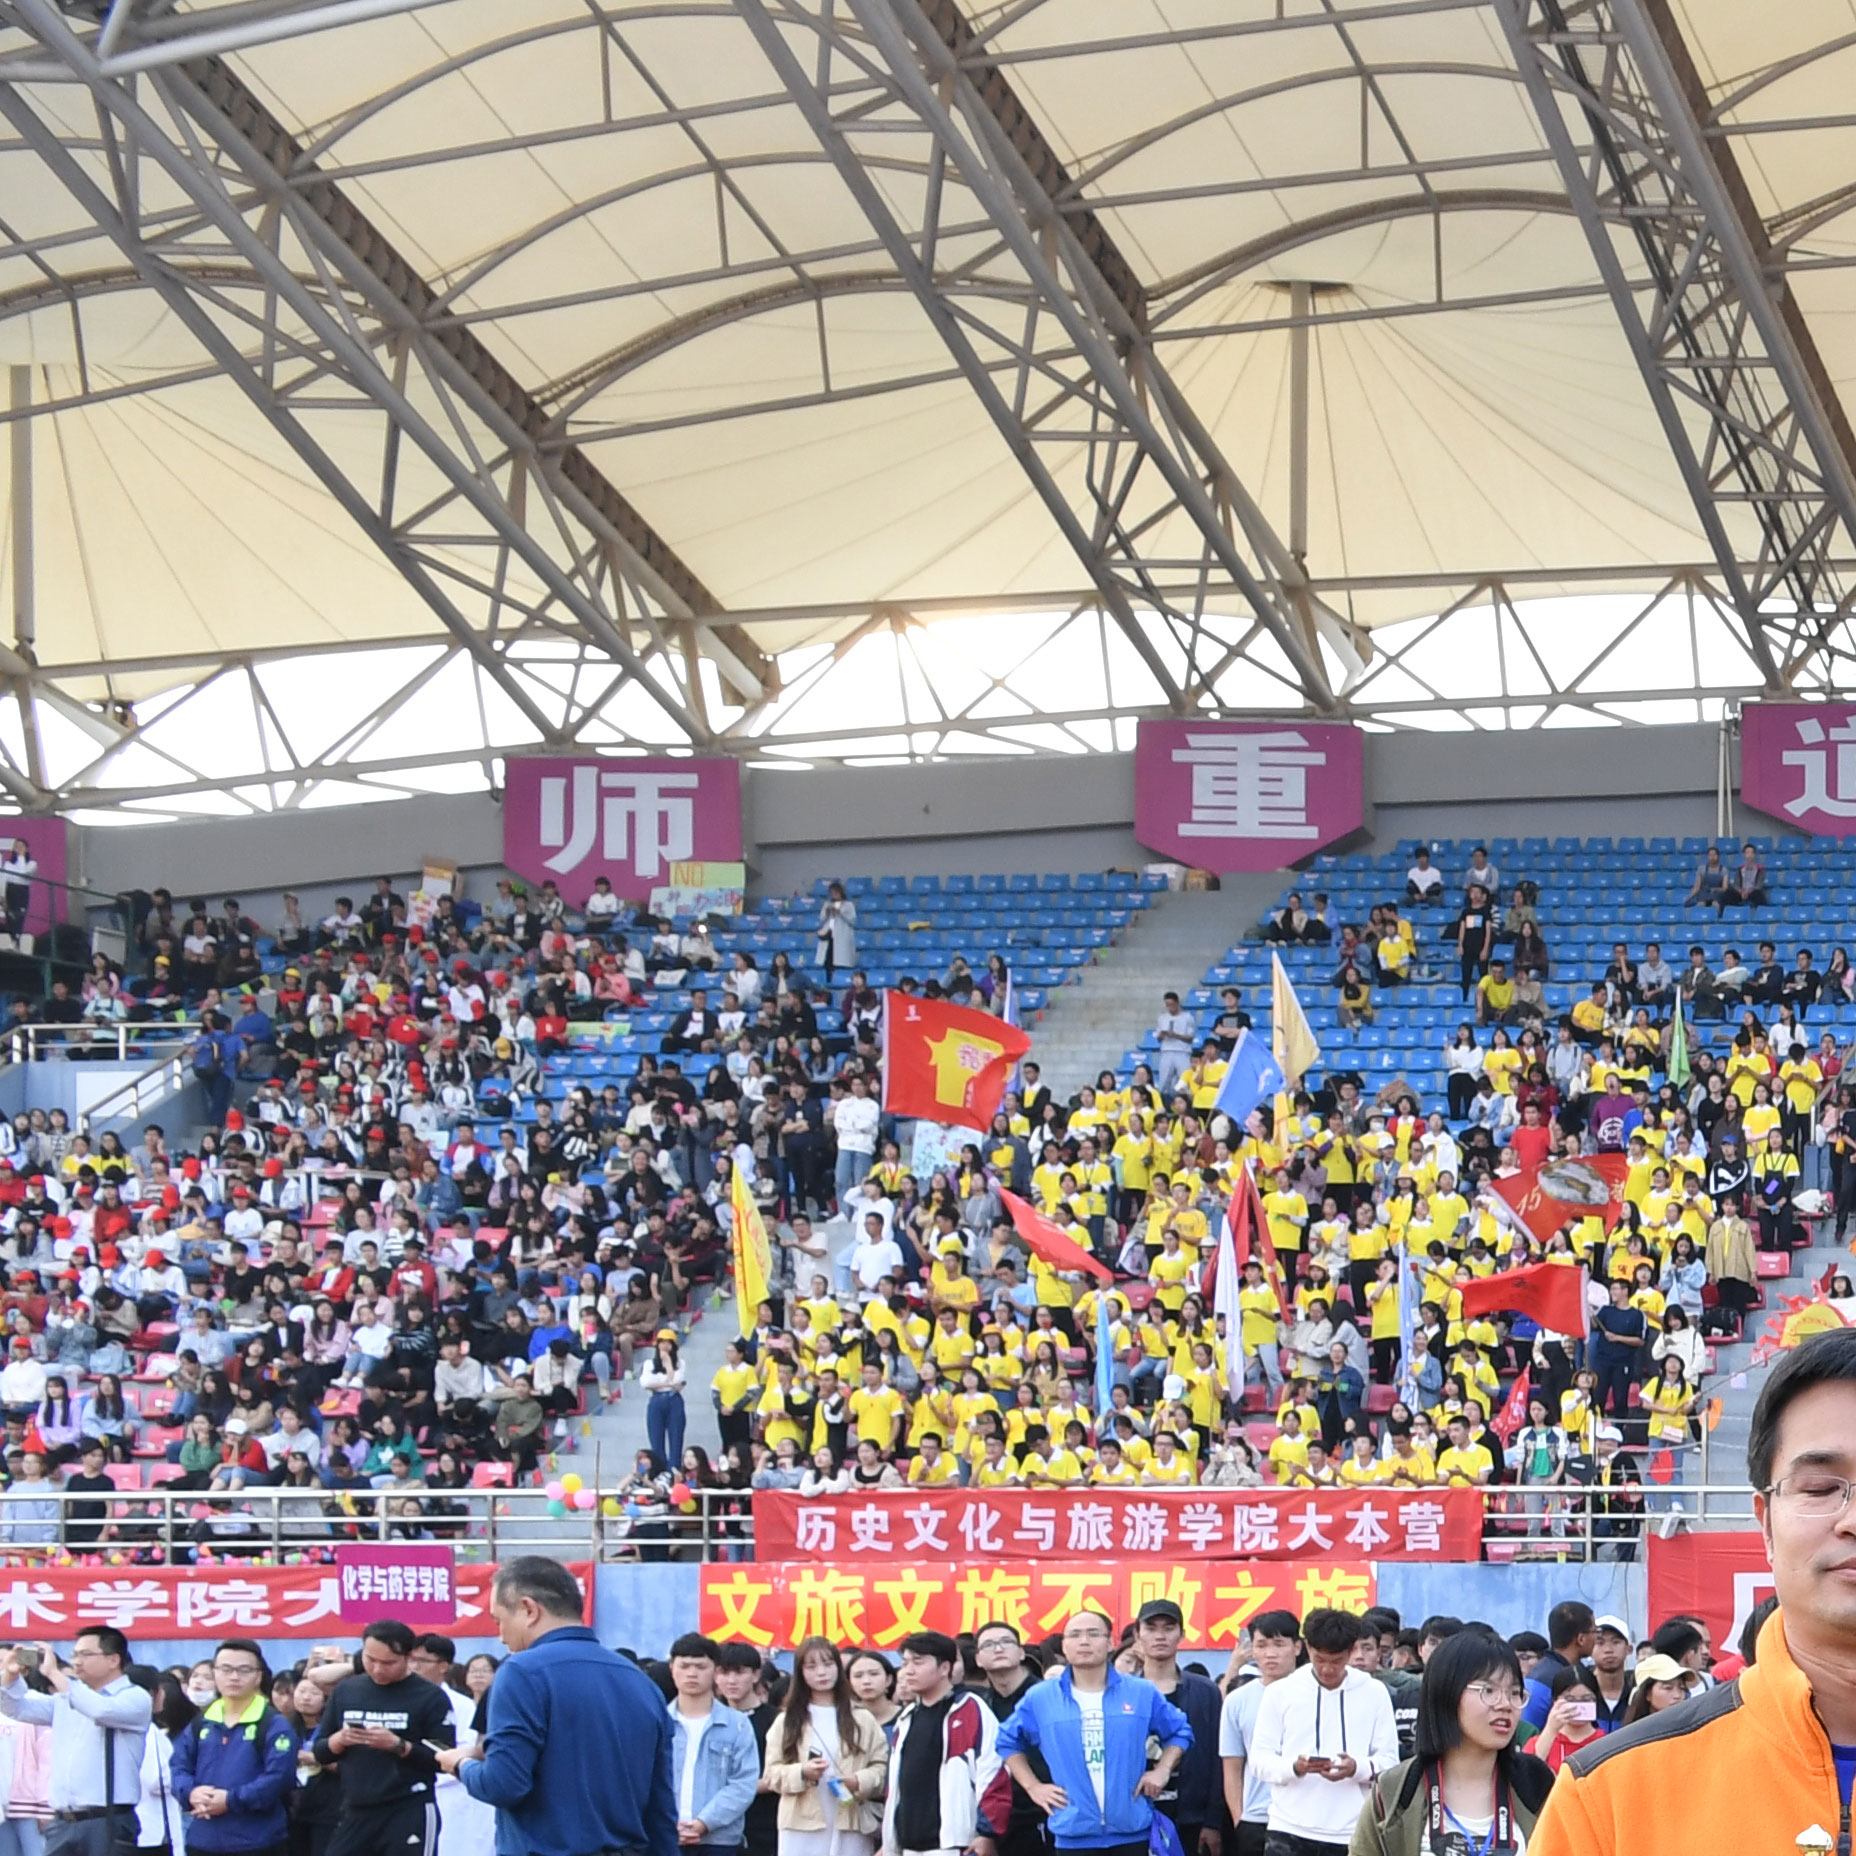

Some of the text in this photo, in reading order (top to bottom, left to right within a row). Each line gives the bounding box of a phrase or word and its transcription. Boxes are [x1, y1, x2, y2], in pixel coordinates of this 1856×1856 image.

[540, 766, 699, 878] 师
[1171, 731, 1326, 839] 重
[795, 1500, 1447, 1555] 历史文化与旅游学院大本营
[341, 1565, 450, 1604] 化学与药学学院
